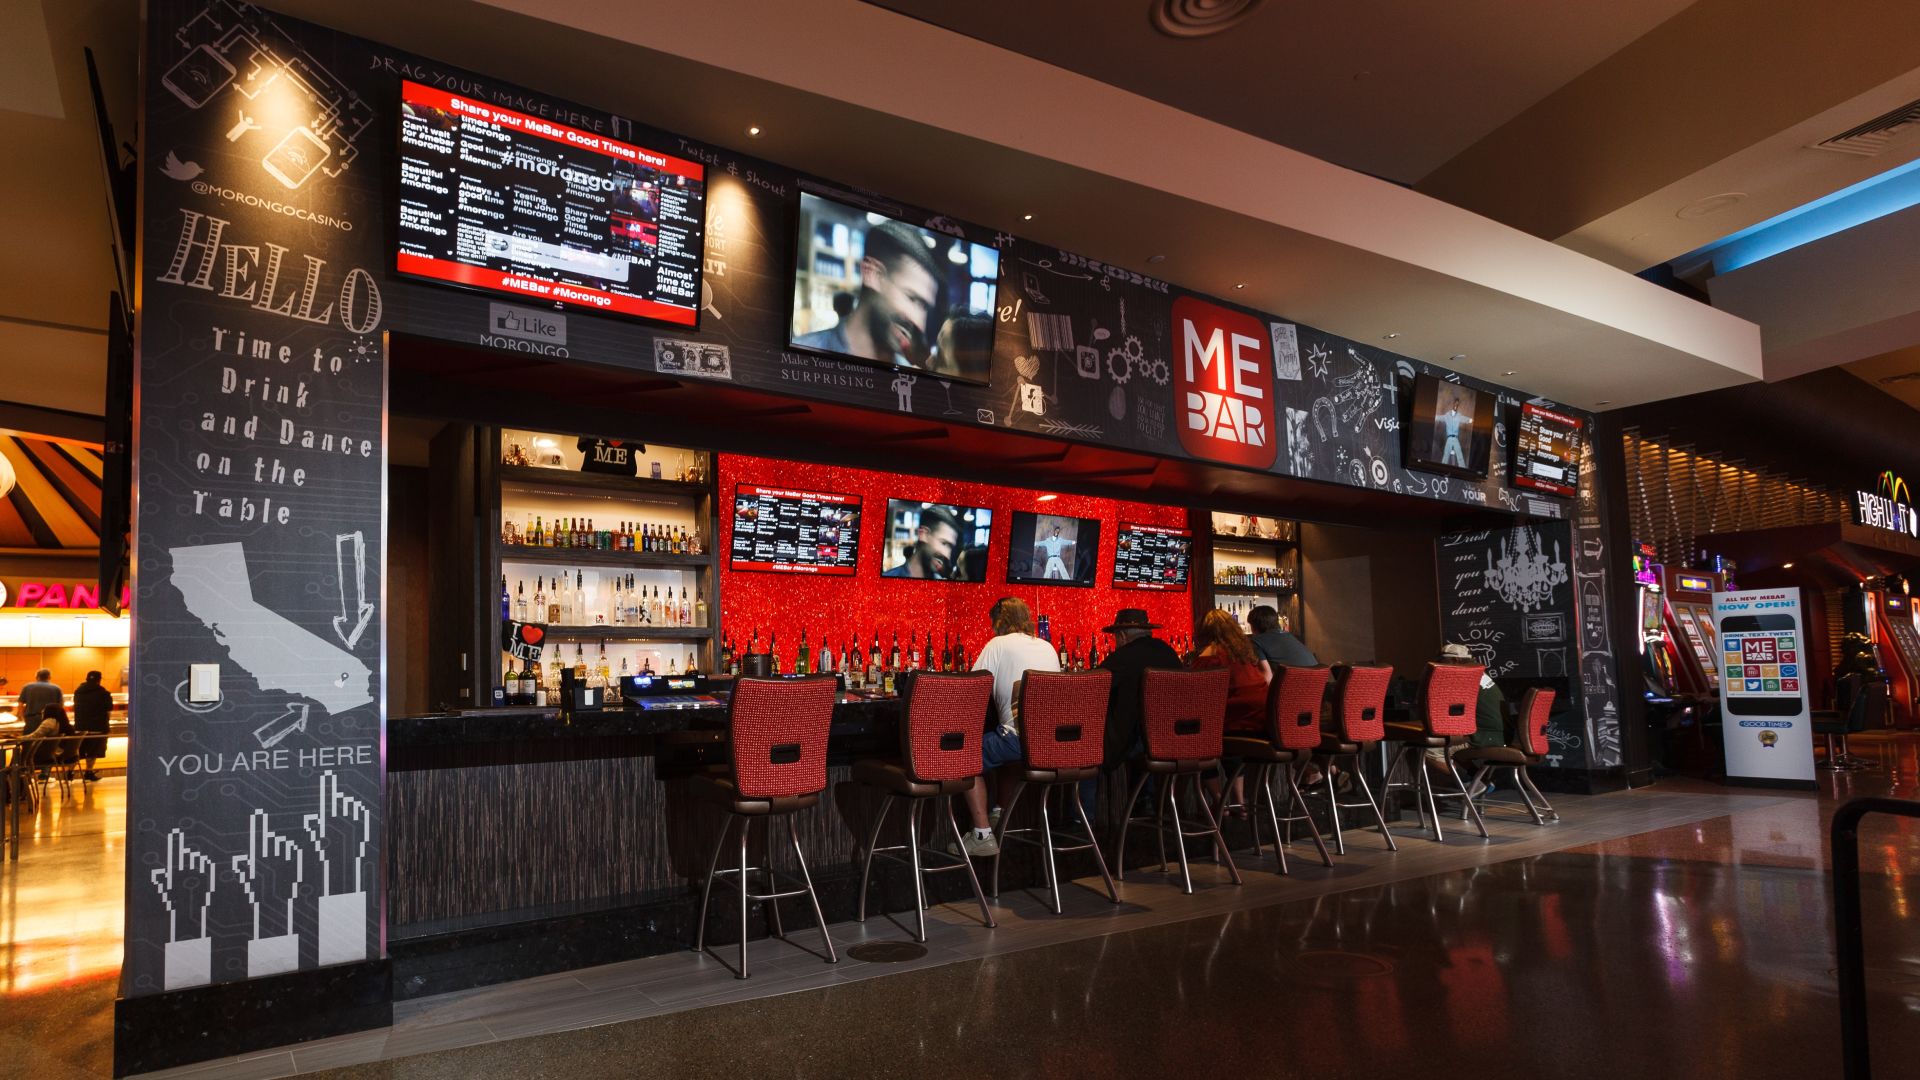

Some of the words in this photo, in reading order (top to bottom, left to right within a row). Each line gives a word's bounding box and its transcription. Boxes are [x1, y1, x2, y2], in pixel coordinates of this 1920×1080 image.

[369, 55, 426, 80] DRAG
[433, 71, 485, 98] YOUR
[493, 91, 550, 116] IMAGE
[555, 109, 603, 132] HERE
[402, 120, 429, 133] Can't
[430, 128, 450, 139] wait
[451, 98, 490, 118] Share
[493, 111, 522, 127] your
[525, 119, 564, 138] MeBar
[567, 131, 599, 148] Good
[602, 140, 636, 159] Times
[639, 151, 666, 167] here!
[461, 115, 489, 128] times
[491, 123, 501, 132] at
[461, 123, 512, 142] #Morongo
[402, 127, 416, 137] for
[419, 132, 455, 147] #mebar
[402, 136, 452, 154] #morongo
[460, 140, 484, 152] Good
[401, 170, 419, 182] Day
[422, 174, 431, 183] at
[402, 162, 443, 180] Beautiful
[500, 150, 615, 191] #morongo
[678, 139, 720, 167] Twist
[727, 160, 739, 176] &
[746, 170, 786, 197] Shout
[401, 177, 449, 195] #morongo
[459, 181, 493, 196] Always
[459, 189, 483, 201] good
[484, 195, 505, 206] time
[513, 190, 548, 206] Testing
[565, 188, 606, 203] #morongo
[191, 180, 353, 231] @MORONGOCASINO
[400, 205, 442, 221] Beautiful
[458, 203, 505, 220] #morongo
[513, 198, 533, 209] with
[534, 202, 557, 214] John
[513, 206, 559, 222] #morongo
[565, 206, 588, 219] Share
[589, 213, 607, 223] your
[400, 212, 419, 224] Day
[420, 217, 430, 225] at
[400, 219, 448, 236] #morongo
[564, 213, 587, 224] Good
[564, 220, 588, 231] Times
[156, 208, 382, 334] HELLO
[657, 266, 693, 281] Almost
[502, 277, 550, 294] #MEBar
[553, 287, 612, 305] #Morongo
[656, 275, 679, 286] time
[680, 279, 695, 290] for
[656, 284, 695, 299] #MEBar
[523, 317, 557, 337] Like
[212, 326, 292, 364] Time
[312, 347, 343, 375] to
[480, 334, 570, 359] MORONGO
[781, 353, 809, 368] Make
[810, 356, 836, 370] Your
[837, 360, 874, 375] Content
[1183, 318, 1264, 399] ME
[221, 366, 309, 408] Drink
[781, 368, 874, 389] SURPRISING
[1186, 390, 1266, 447] BAR
[201, 412, 258, 441] and
[279, 419, 372, 458] Dance
[1538, 434, 1552, 443] Good
[1539, 425, 1553, 436] Share
[593, 445, 628, 465] ME
[1538, 441, 1552, 451] Times
[197, 452, 231, 476] on
[254, 456, 306, 486] the
[1462, 488, 1487, 502] YOUR
[193, 490, 290, 525] Table
[1454, 570, 1480, 590] you
[15, 583, 130, 609] PAN
[1458, 588, 1483, 598] can
[1718, 603, 1749, 611] NOW
[1755, 600, 1797, 609] OPEN!
[512, 622, 521, 640] I
[1458, 629, 1506, 643] LOVE
[509, 637, 542, 662] ME
[1745, 640, 1774, 653] ME
[1746, 653, 1774, 661] BAR
[1489, 660, 1520, 679] BAR
[158, 753, 224, 777] YOU
[231, 749, 289, 772] ARE
[299, 745, 373, 769] HERE
